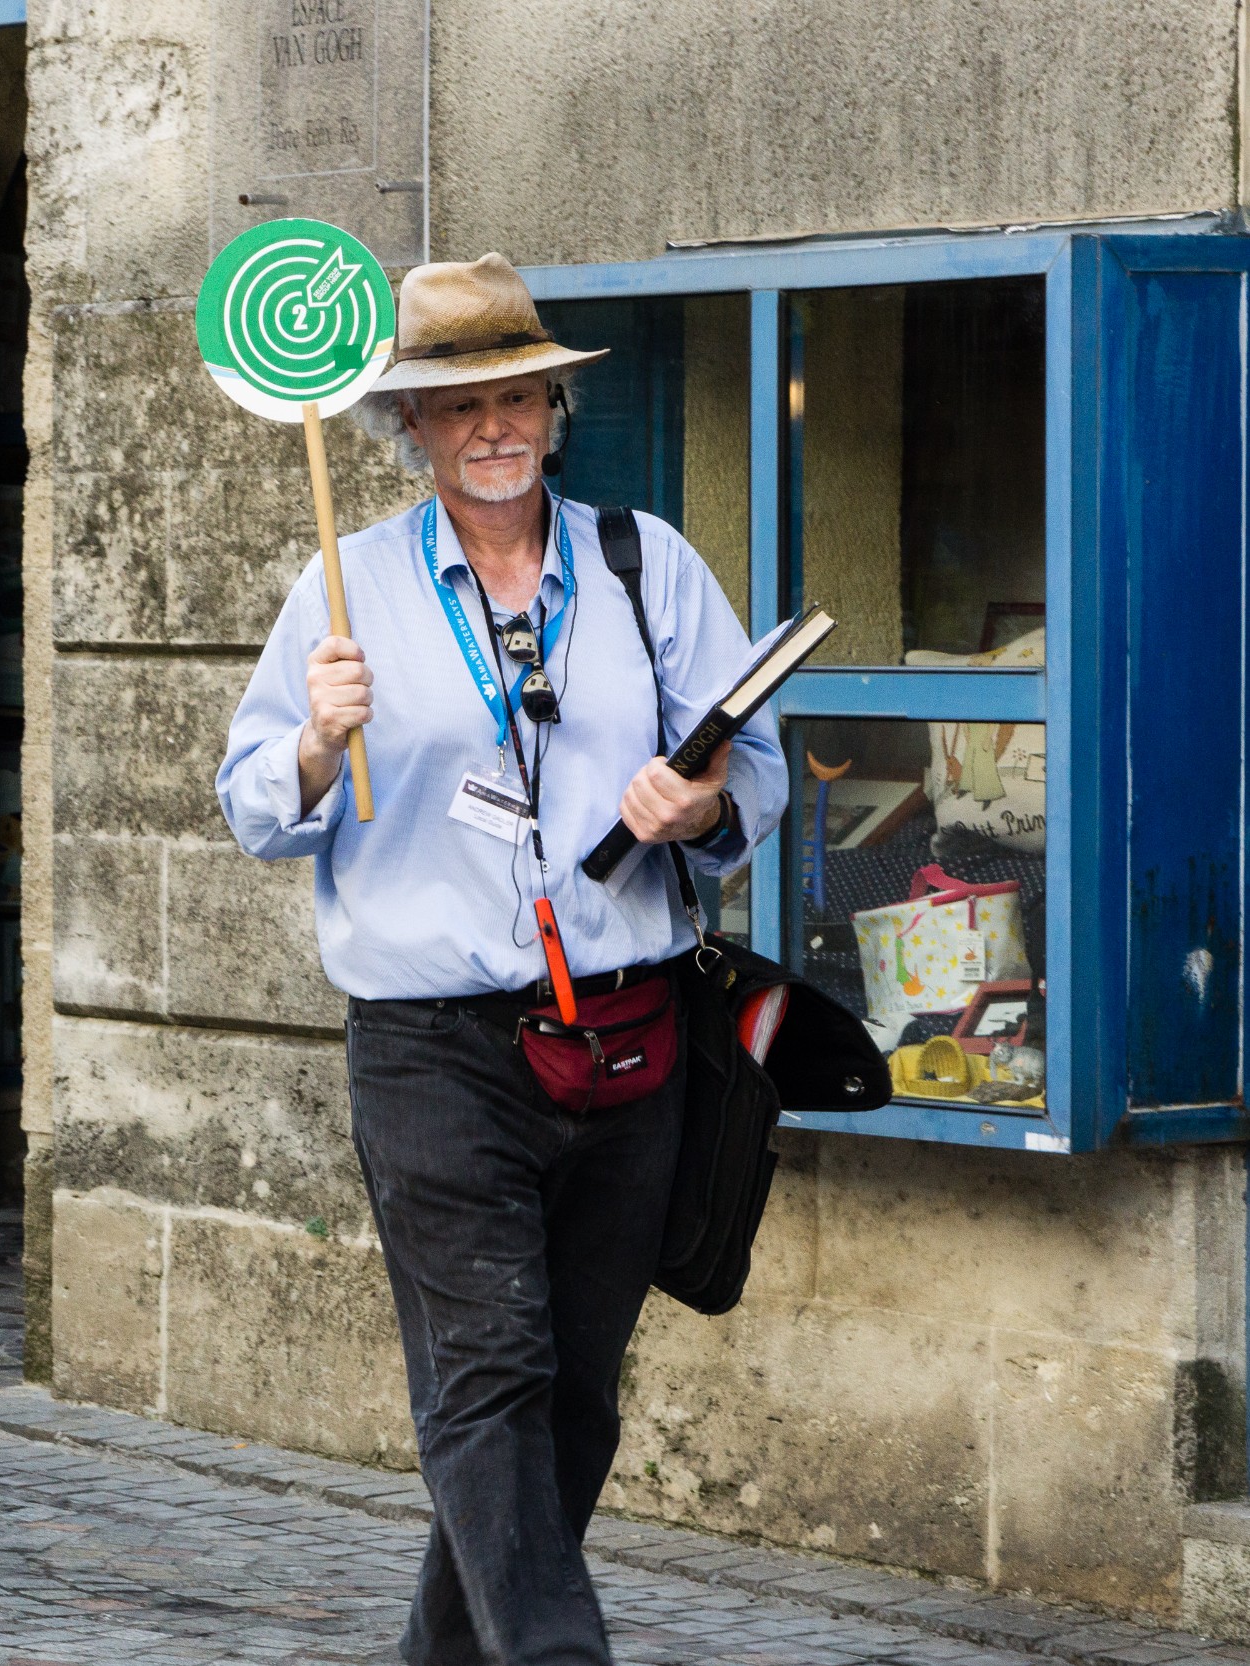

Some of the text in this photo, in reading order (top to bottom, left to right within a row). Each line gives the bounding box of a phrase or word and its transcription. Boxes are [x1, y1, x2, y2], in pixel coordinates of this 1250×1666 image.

[313, 27, 362, 65] GOGH
[291, 303, 308, 331] 2
[448, 598, 490, 681] AMAWATERWAYS
[683, 722, 722, 762] GOGH
[612, 1055, 643, 1071] EASTPAK
